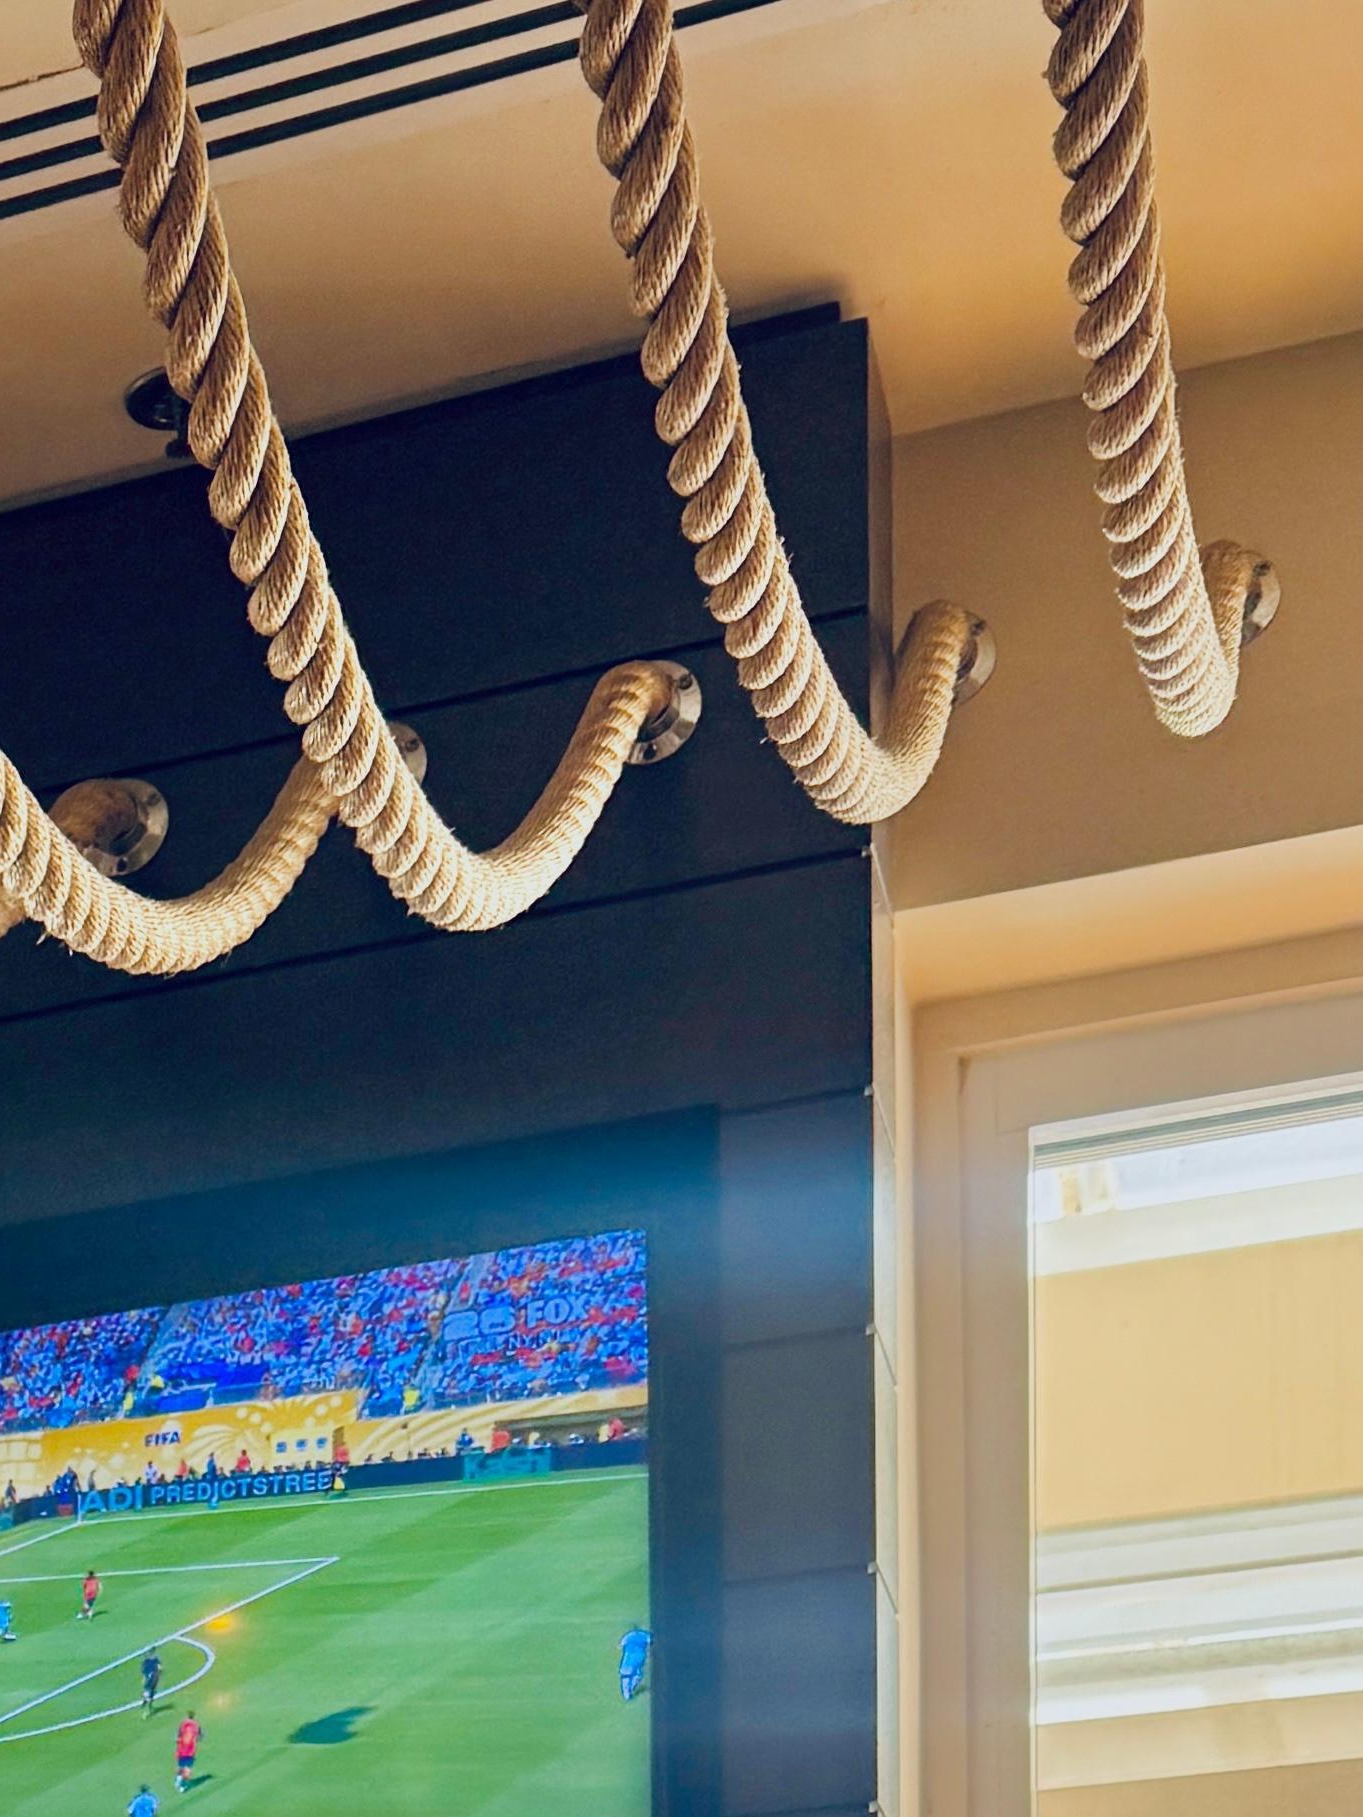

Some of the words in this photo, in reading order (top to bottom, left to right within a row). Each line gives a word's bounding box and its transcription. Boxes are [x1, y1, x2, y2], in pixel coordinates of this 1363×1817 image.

[526, 1299, 589, 1328] FOX
[144, 1430, 182, 1448] FIFA
[81, 1484, 143, 1513] ADI
[152, 1470, 333, 1505] PREDICTSTREE
